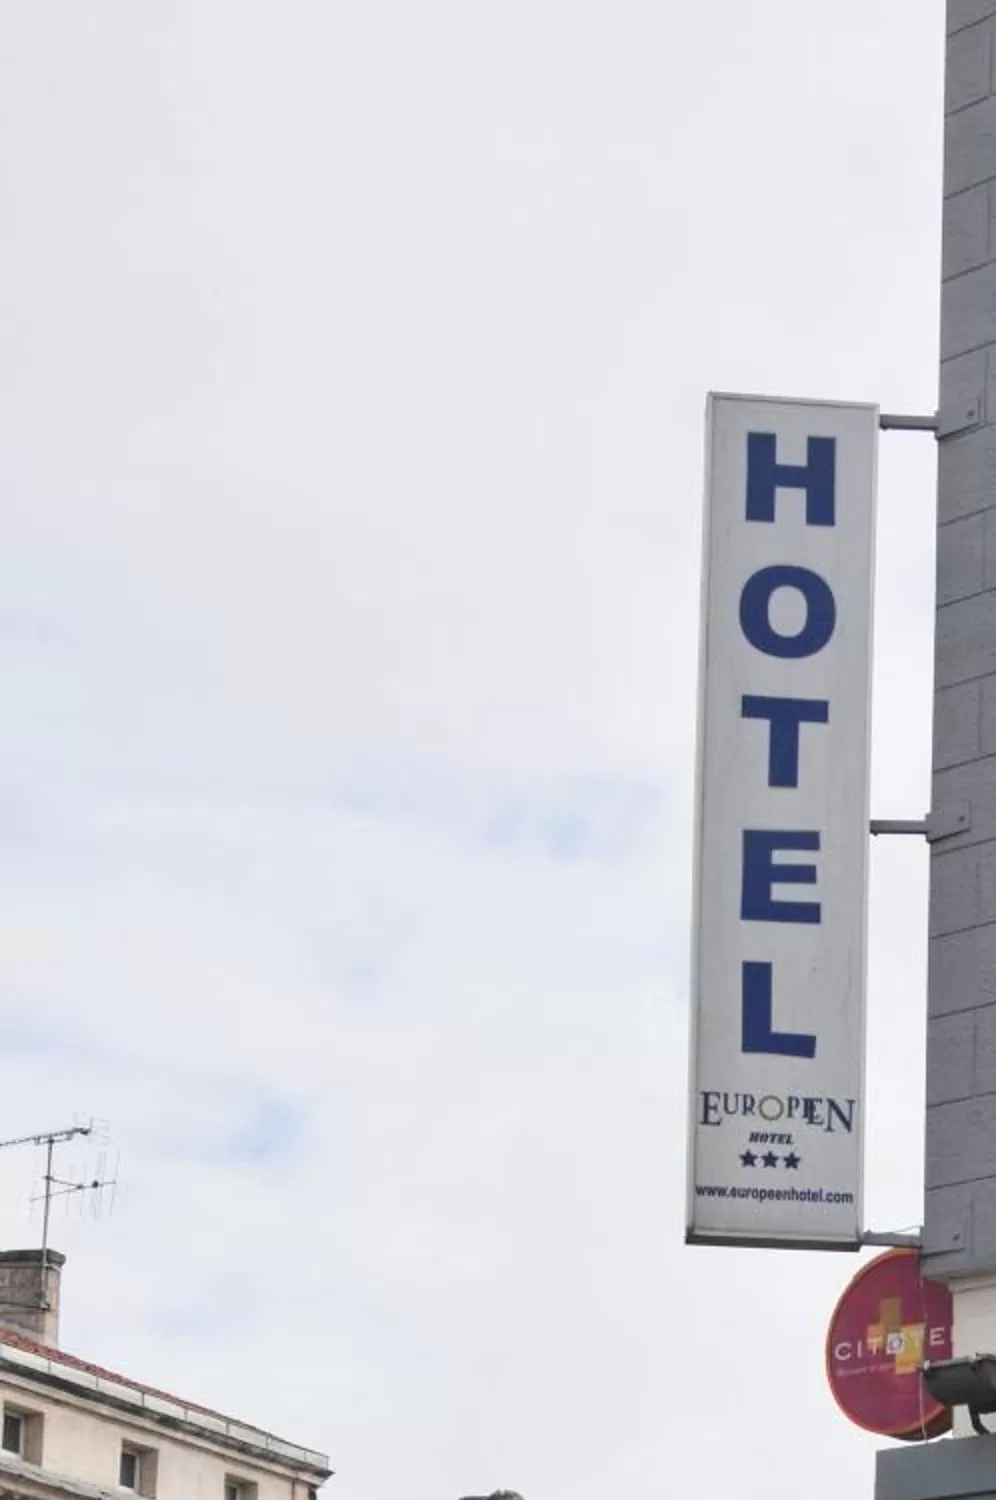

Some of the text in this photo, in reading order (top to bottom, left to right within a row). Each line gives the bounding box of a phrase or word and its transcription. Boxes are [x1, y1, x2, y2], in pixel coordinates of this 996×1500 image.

[739, 432, 837, 1060] HOTEL
[749, 1132, 794, 1145] HOTEL
[695, 1184, 853, 1205] www.europeenhotel.com
